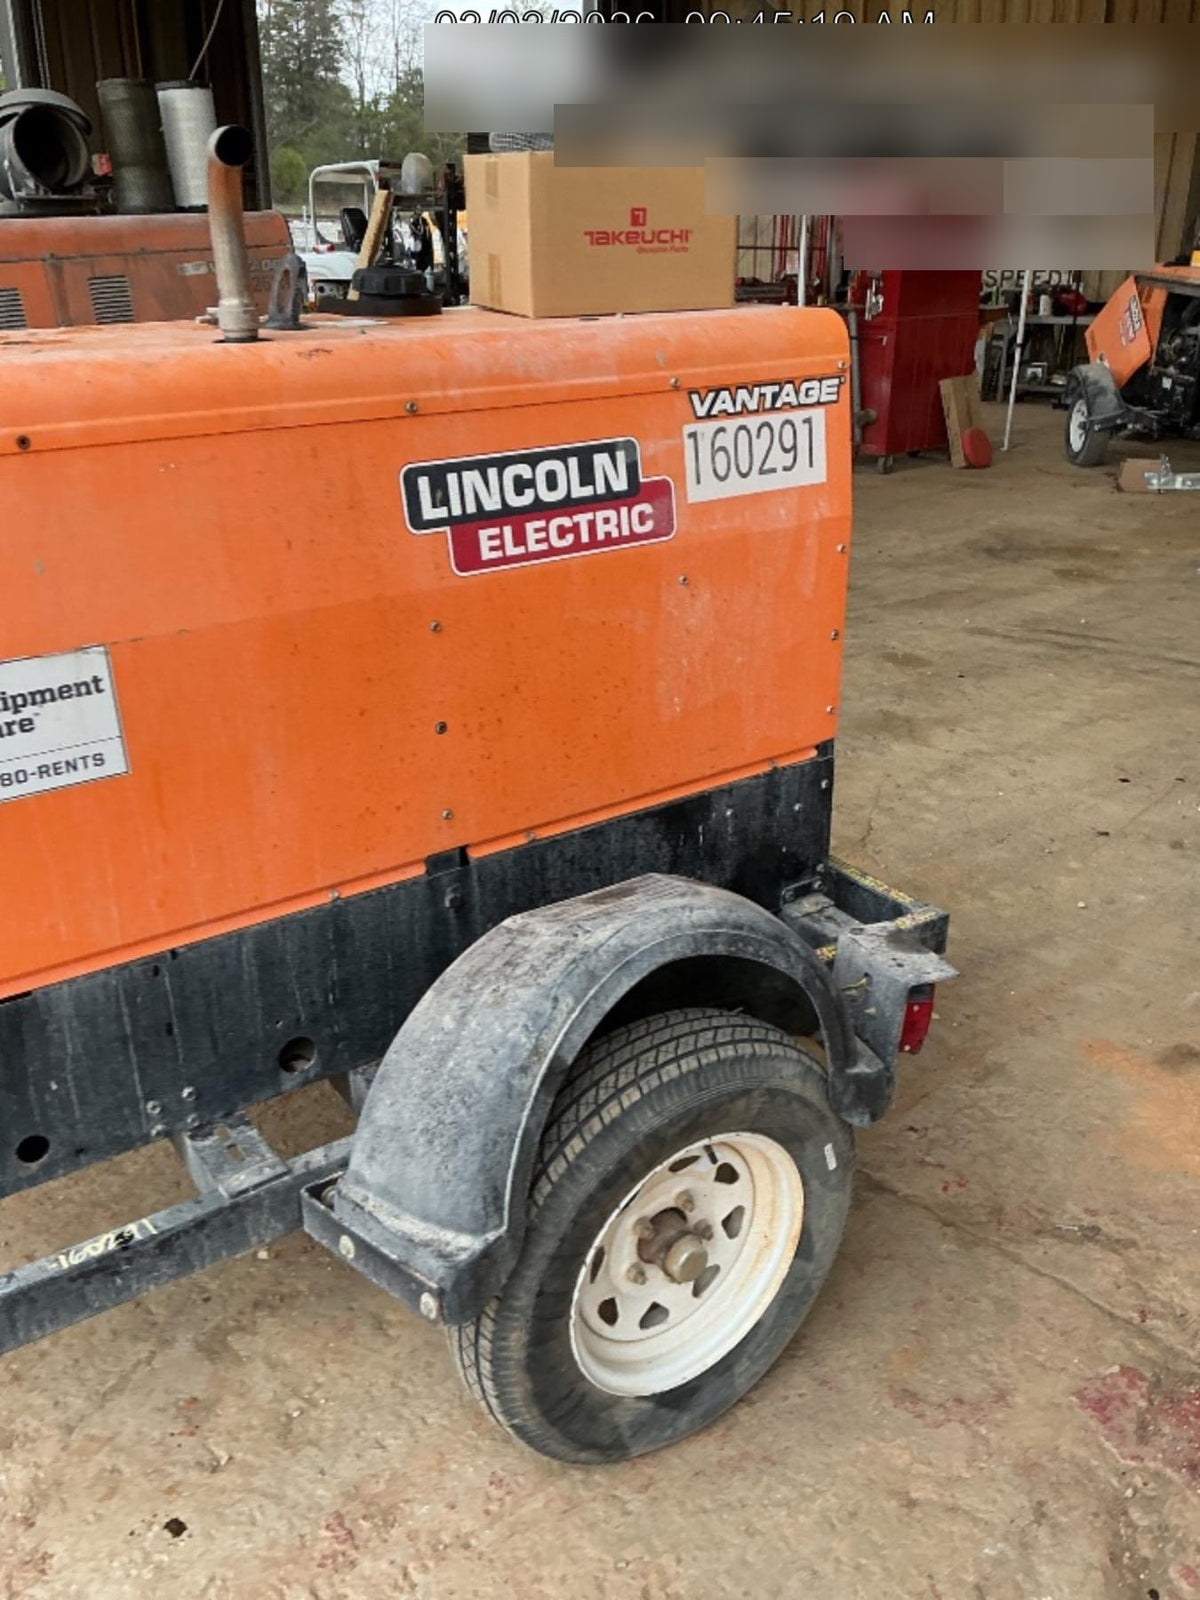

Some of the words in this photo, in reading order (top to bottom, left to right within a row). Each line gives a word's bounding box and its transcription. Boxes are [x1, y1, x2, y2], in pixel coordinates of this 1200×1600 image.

[688, 376, 840, 419] VANTAGE
[687, 416, 813, 485] 160291
[417, 450, 628, 521] LINCOLN
[478, 502, 654, 561] ELECTRIC
[0, 752, 106, 788] 80-RENTS
